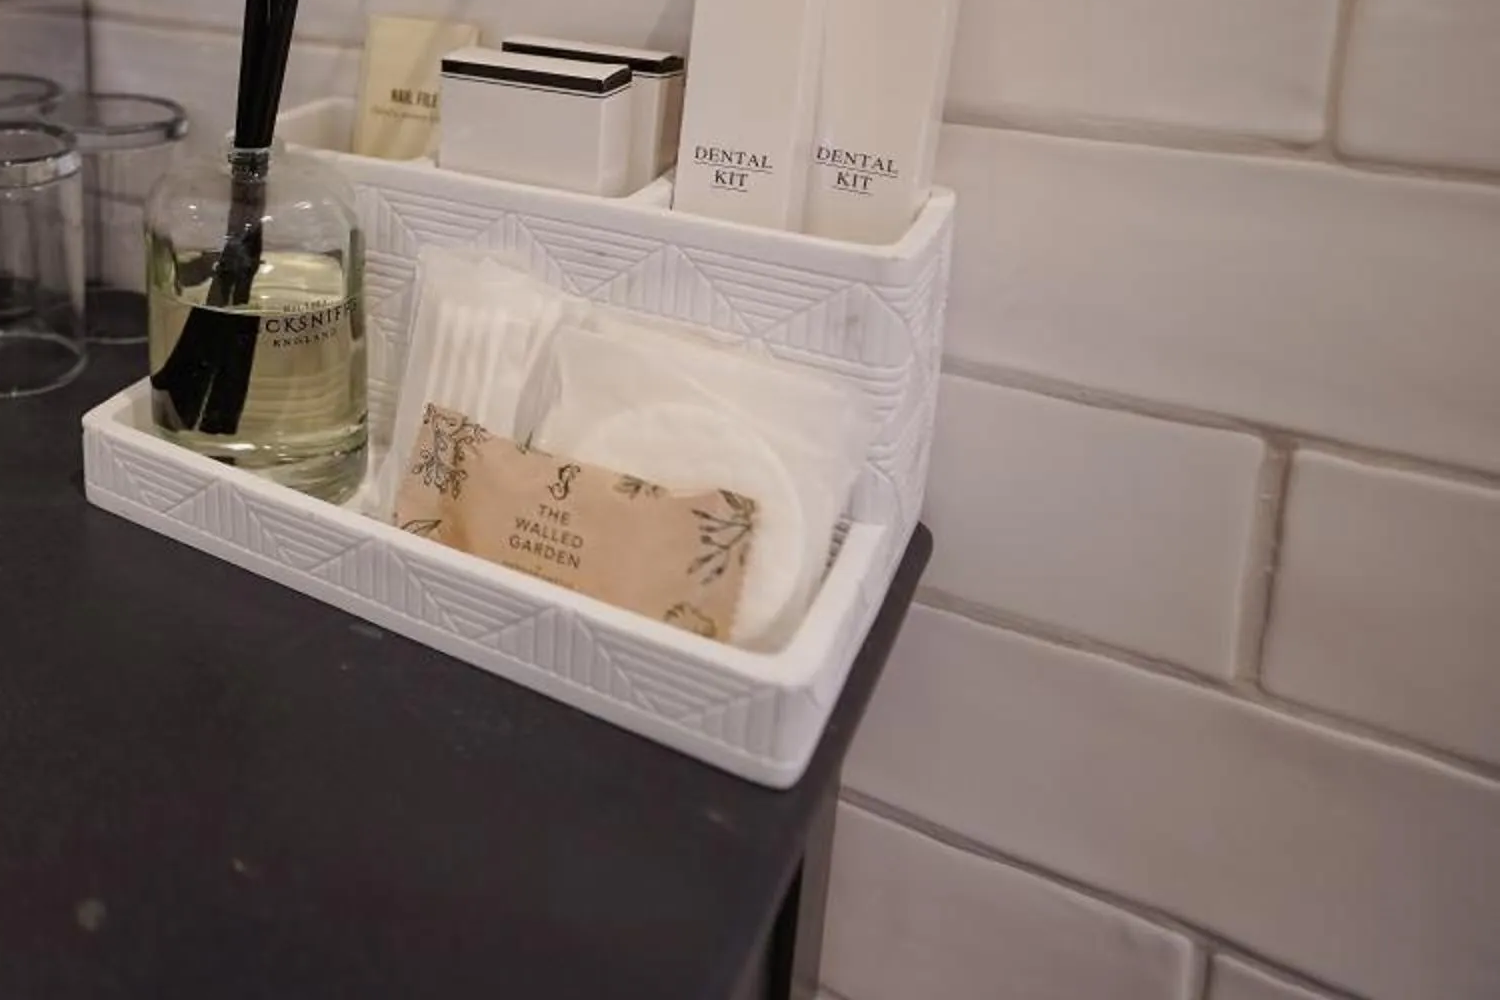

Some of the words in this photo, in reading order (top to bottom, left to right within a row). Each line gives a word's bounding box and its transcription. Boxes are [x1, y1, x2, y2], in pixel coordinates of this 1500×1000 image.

[694, 146, 773, 170] DENTAL
[816, 146, 898, 174] DENTAL
[714, 169, 749, 188] KIT
[836, 171, 873, 191] KIT
[539, 504, 570, 527] THE
[515, 517, 584, 549] WALLED
[509, 535, 581, 569] GARDEN
